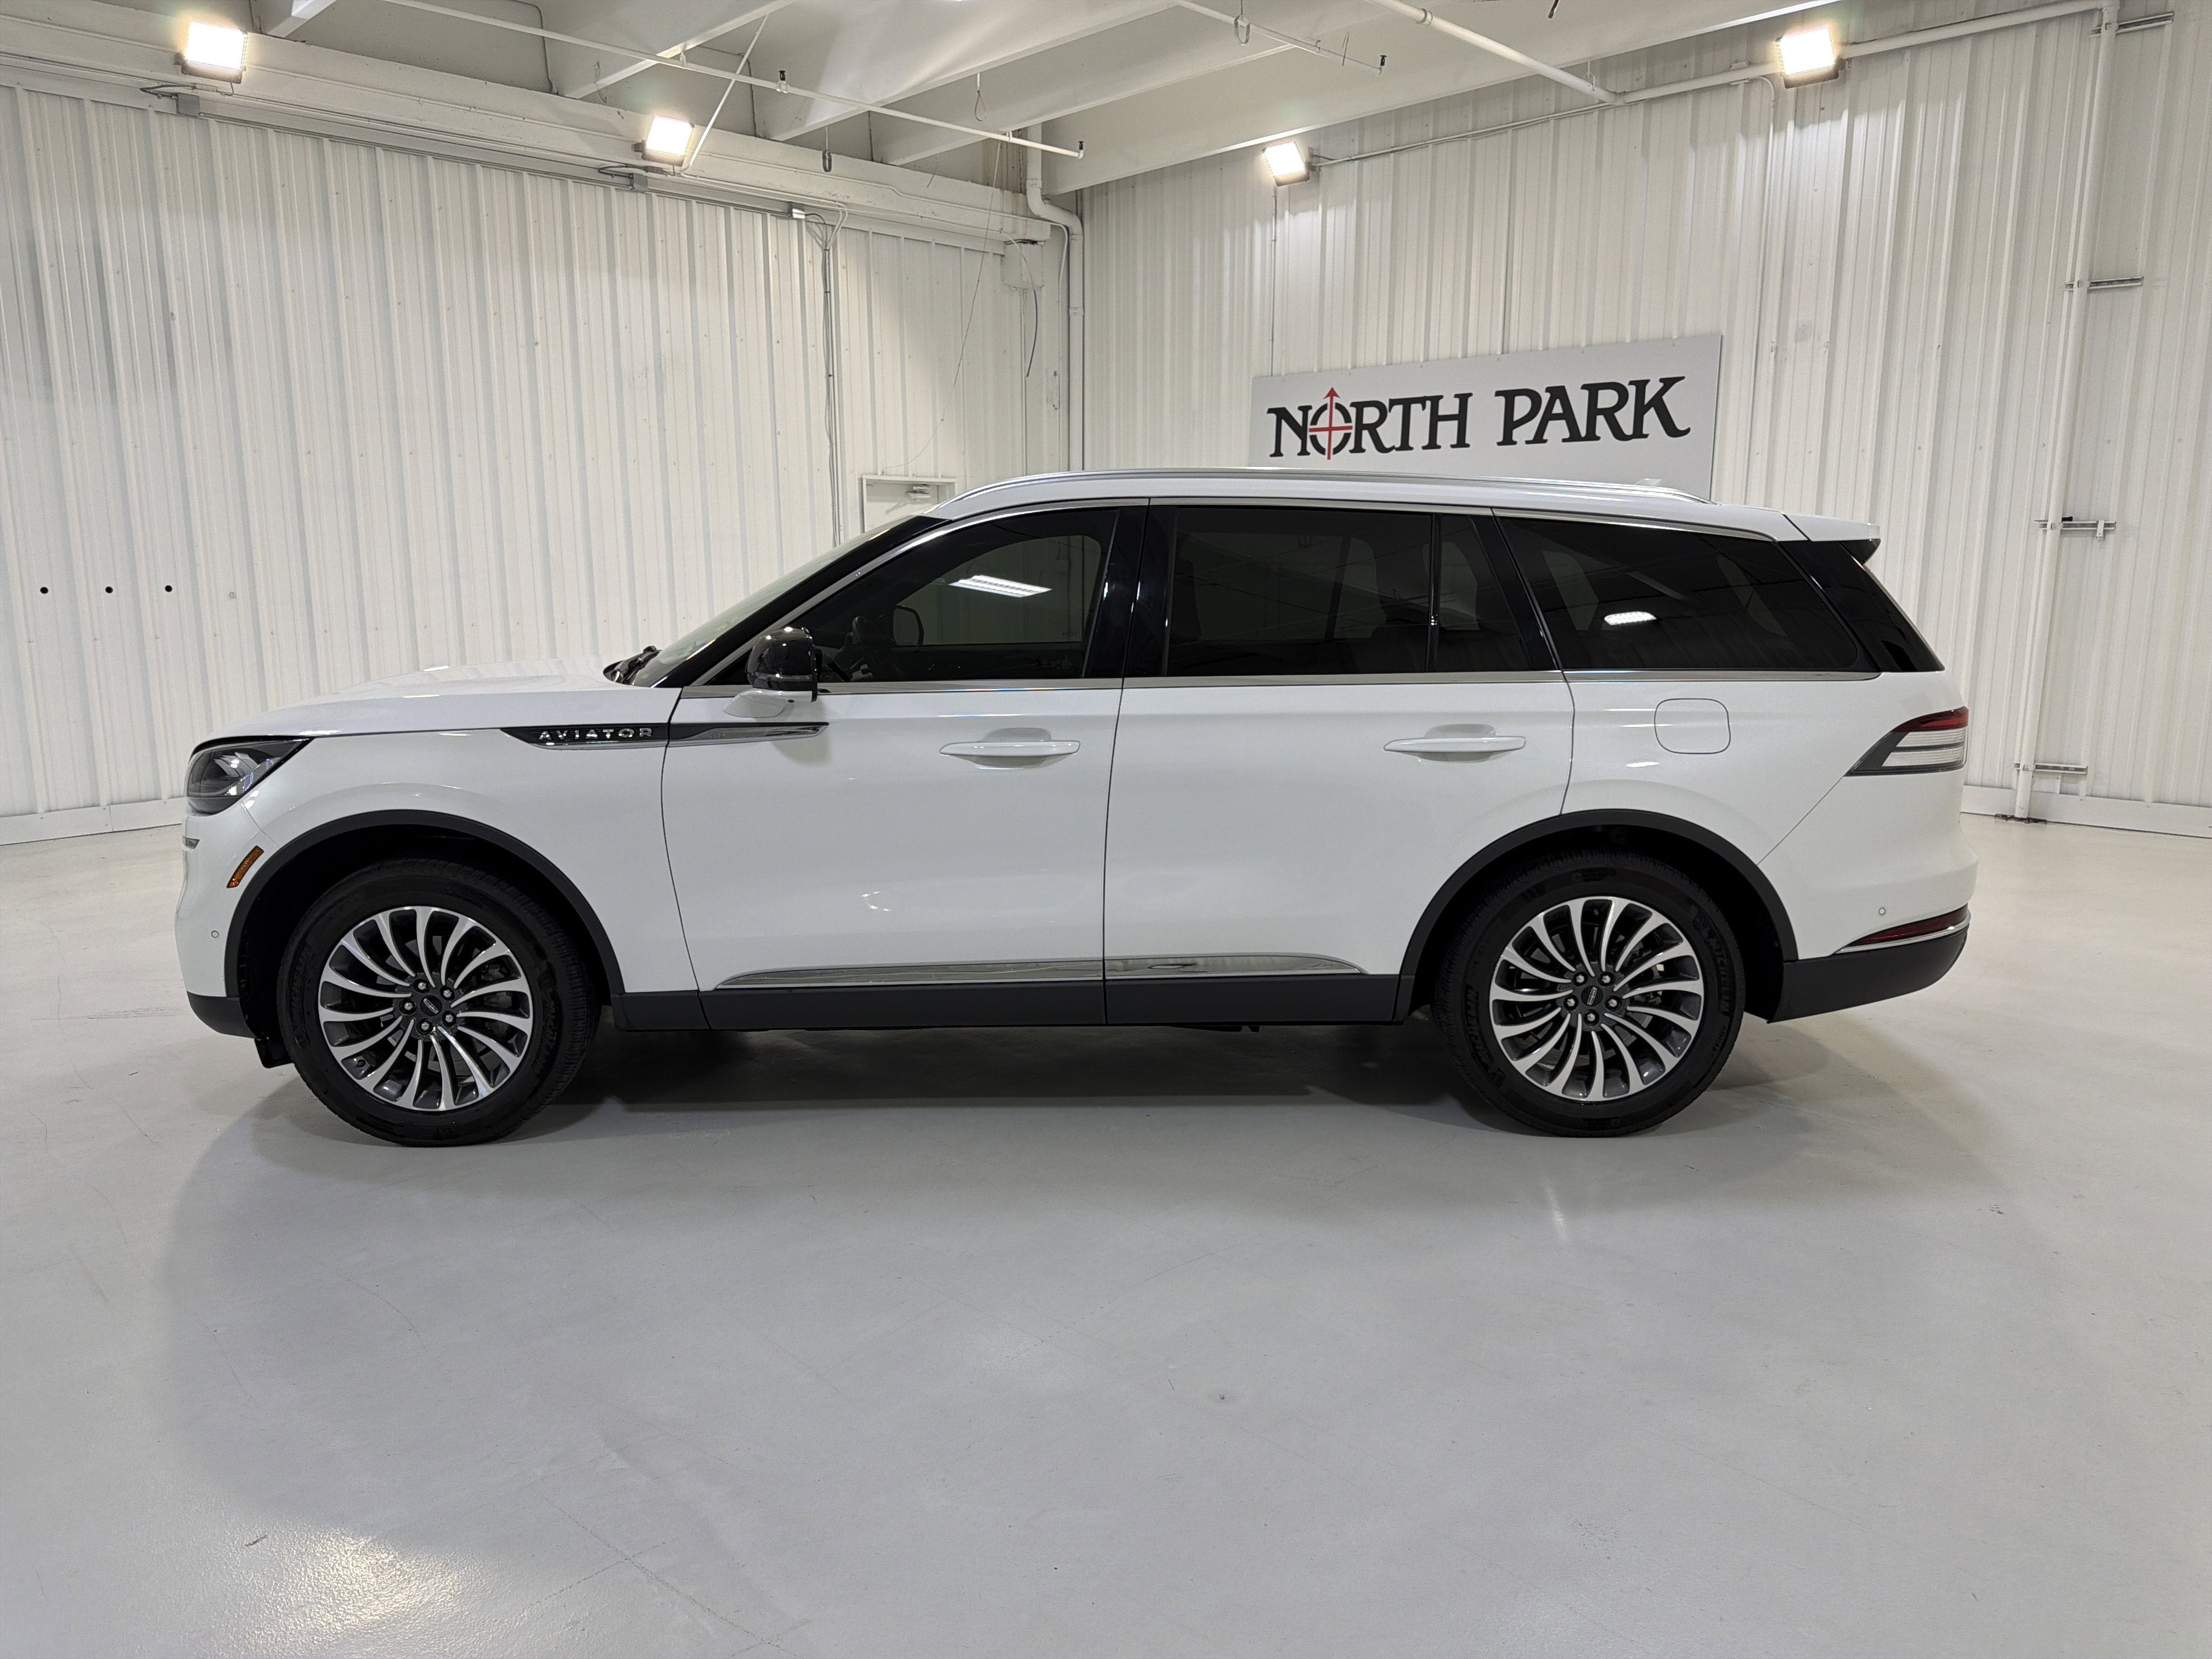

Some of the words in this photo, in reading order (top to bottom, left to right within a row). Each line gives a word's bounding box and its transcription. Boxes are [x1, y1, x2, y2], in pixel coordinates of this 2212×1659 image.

[1266, 392, 1474, 458] NORTH
[1494, 376, 1691, 446] PARK
[539, 727, 653, 740] AVIATOR
